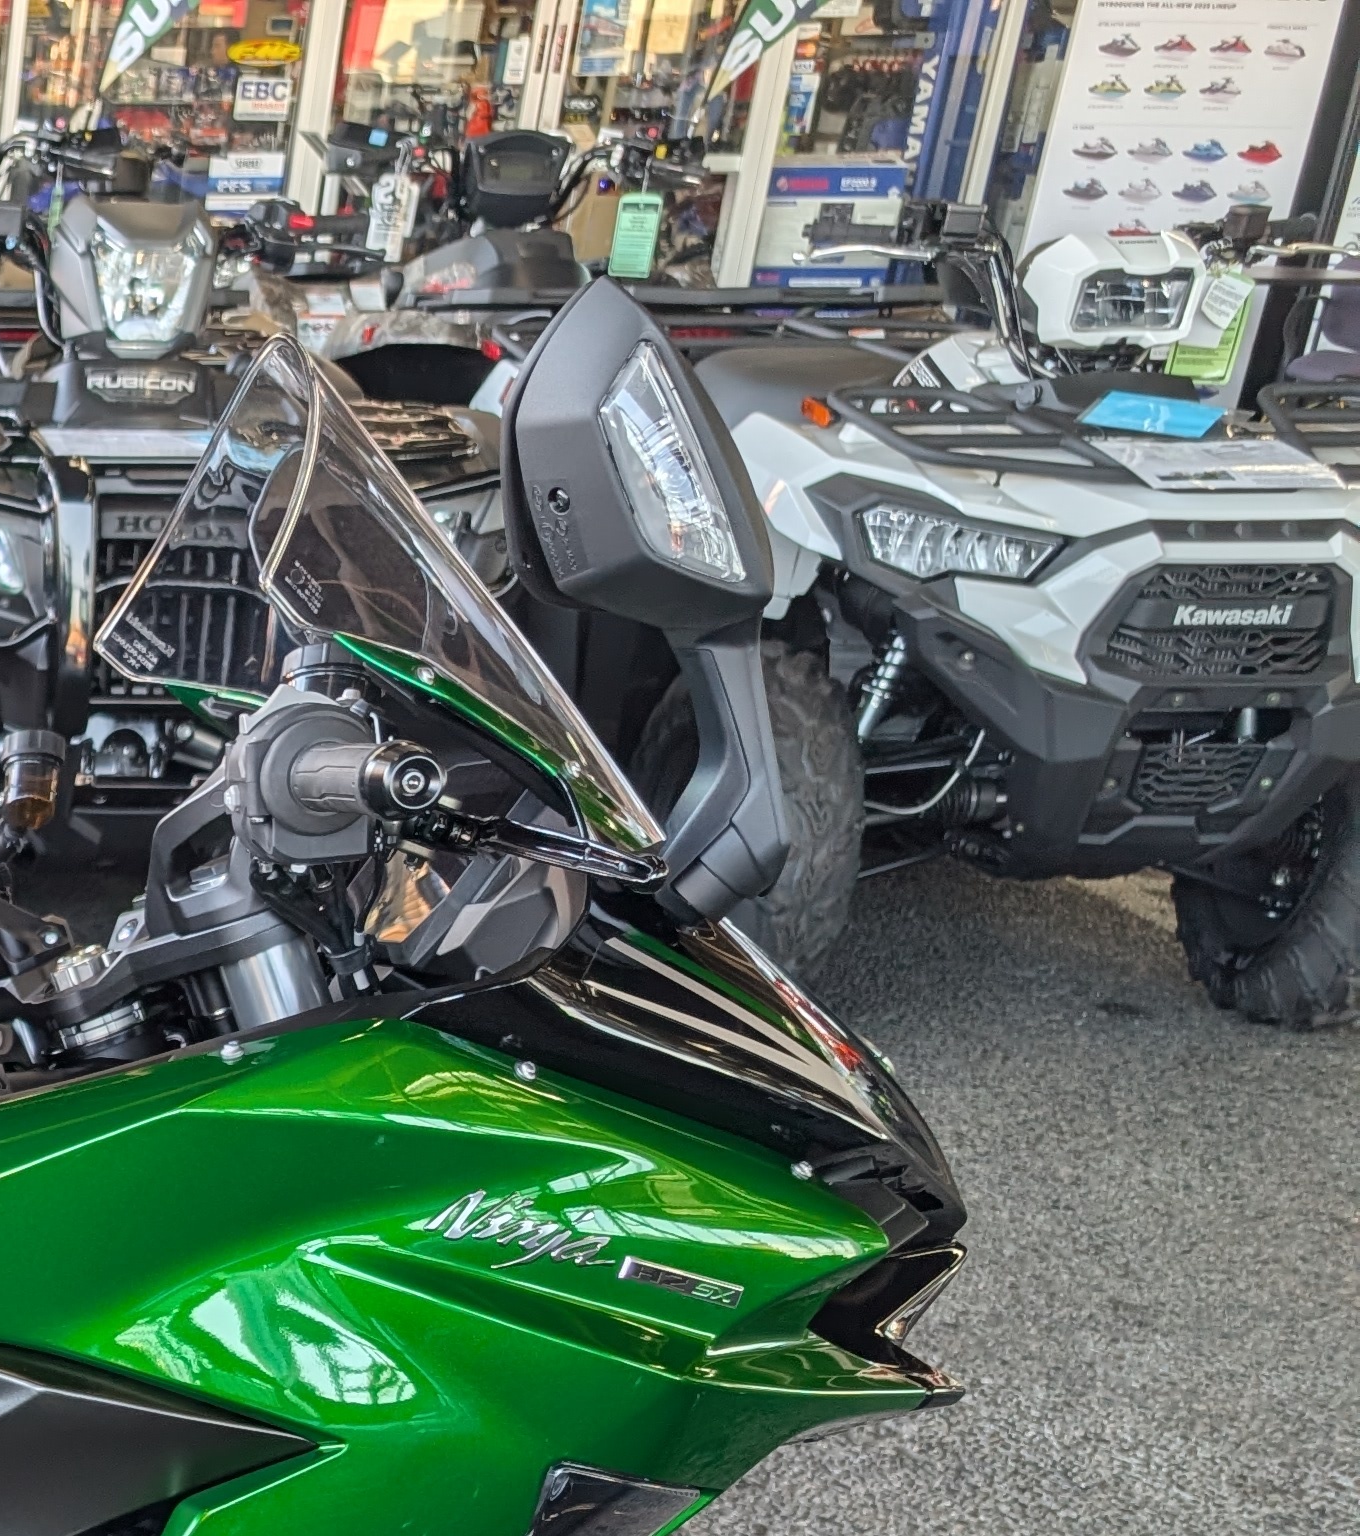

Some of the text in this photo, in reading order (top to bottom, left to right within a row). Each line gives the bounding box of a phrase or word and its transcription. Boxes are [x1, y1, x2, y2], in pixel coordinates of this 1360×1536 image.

[109, 0, 182, 74] SU
[721, 0, 818, 81] SU
[240, 80, 288, 101] EBC
[86, 374, 196, 394] RUBICON
[116, 515, 235, 542] HODA
[1173, 603, 1294, 627] Kawasaki
[423, 1189, 616, 1270] Ninja
[691, 1282, 736, 1304] SX
